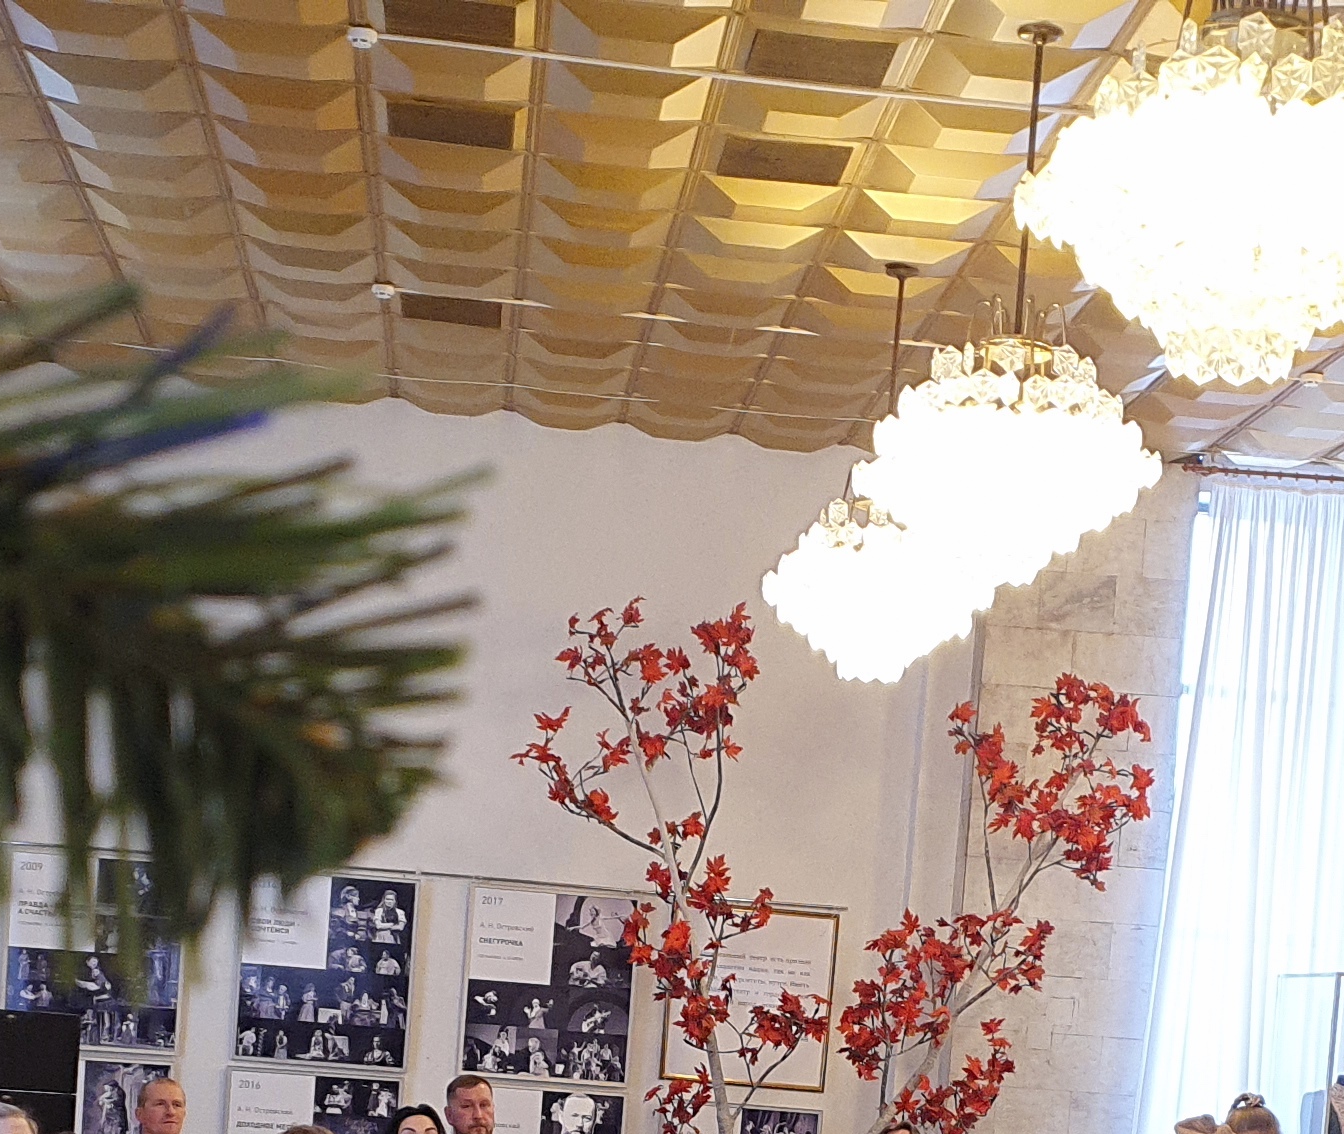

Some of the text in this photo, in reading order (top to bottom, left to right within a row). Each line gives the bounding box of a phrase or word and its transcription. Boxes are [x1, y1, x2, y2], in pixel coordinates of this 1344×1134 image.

[19, 861, 44, 871] 2009
[18, 900, 49, 909] ПРАВДА
[481, 895, 504, 905] 2017
[479, 921, 486, 929] А.
[496, 922, 535, 933] Островский
[478, 936, 524, 948] СНЕГУРОЧКА
[238, 1079, 261, 1090] 2016
